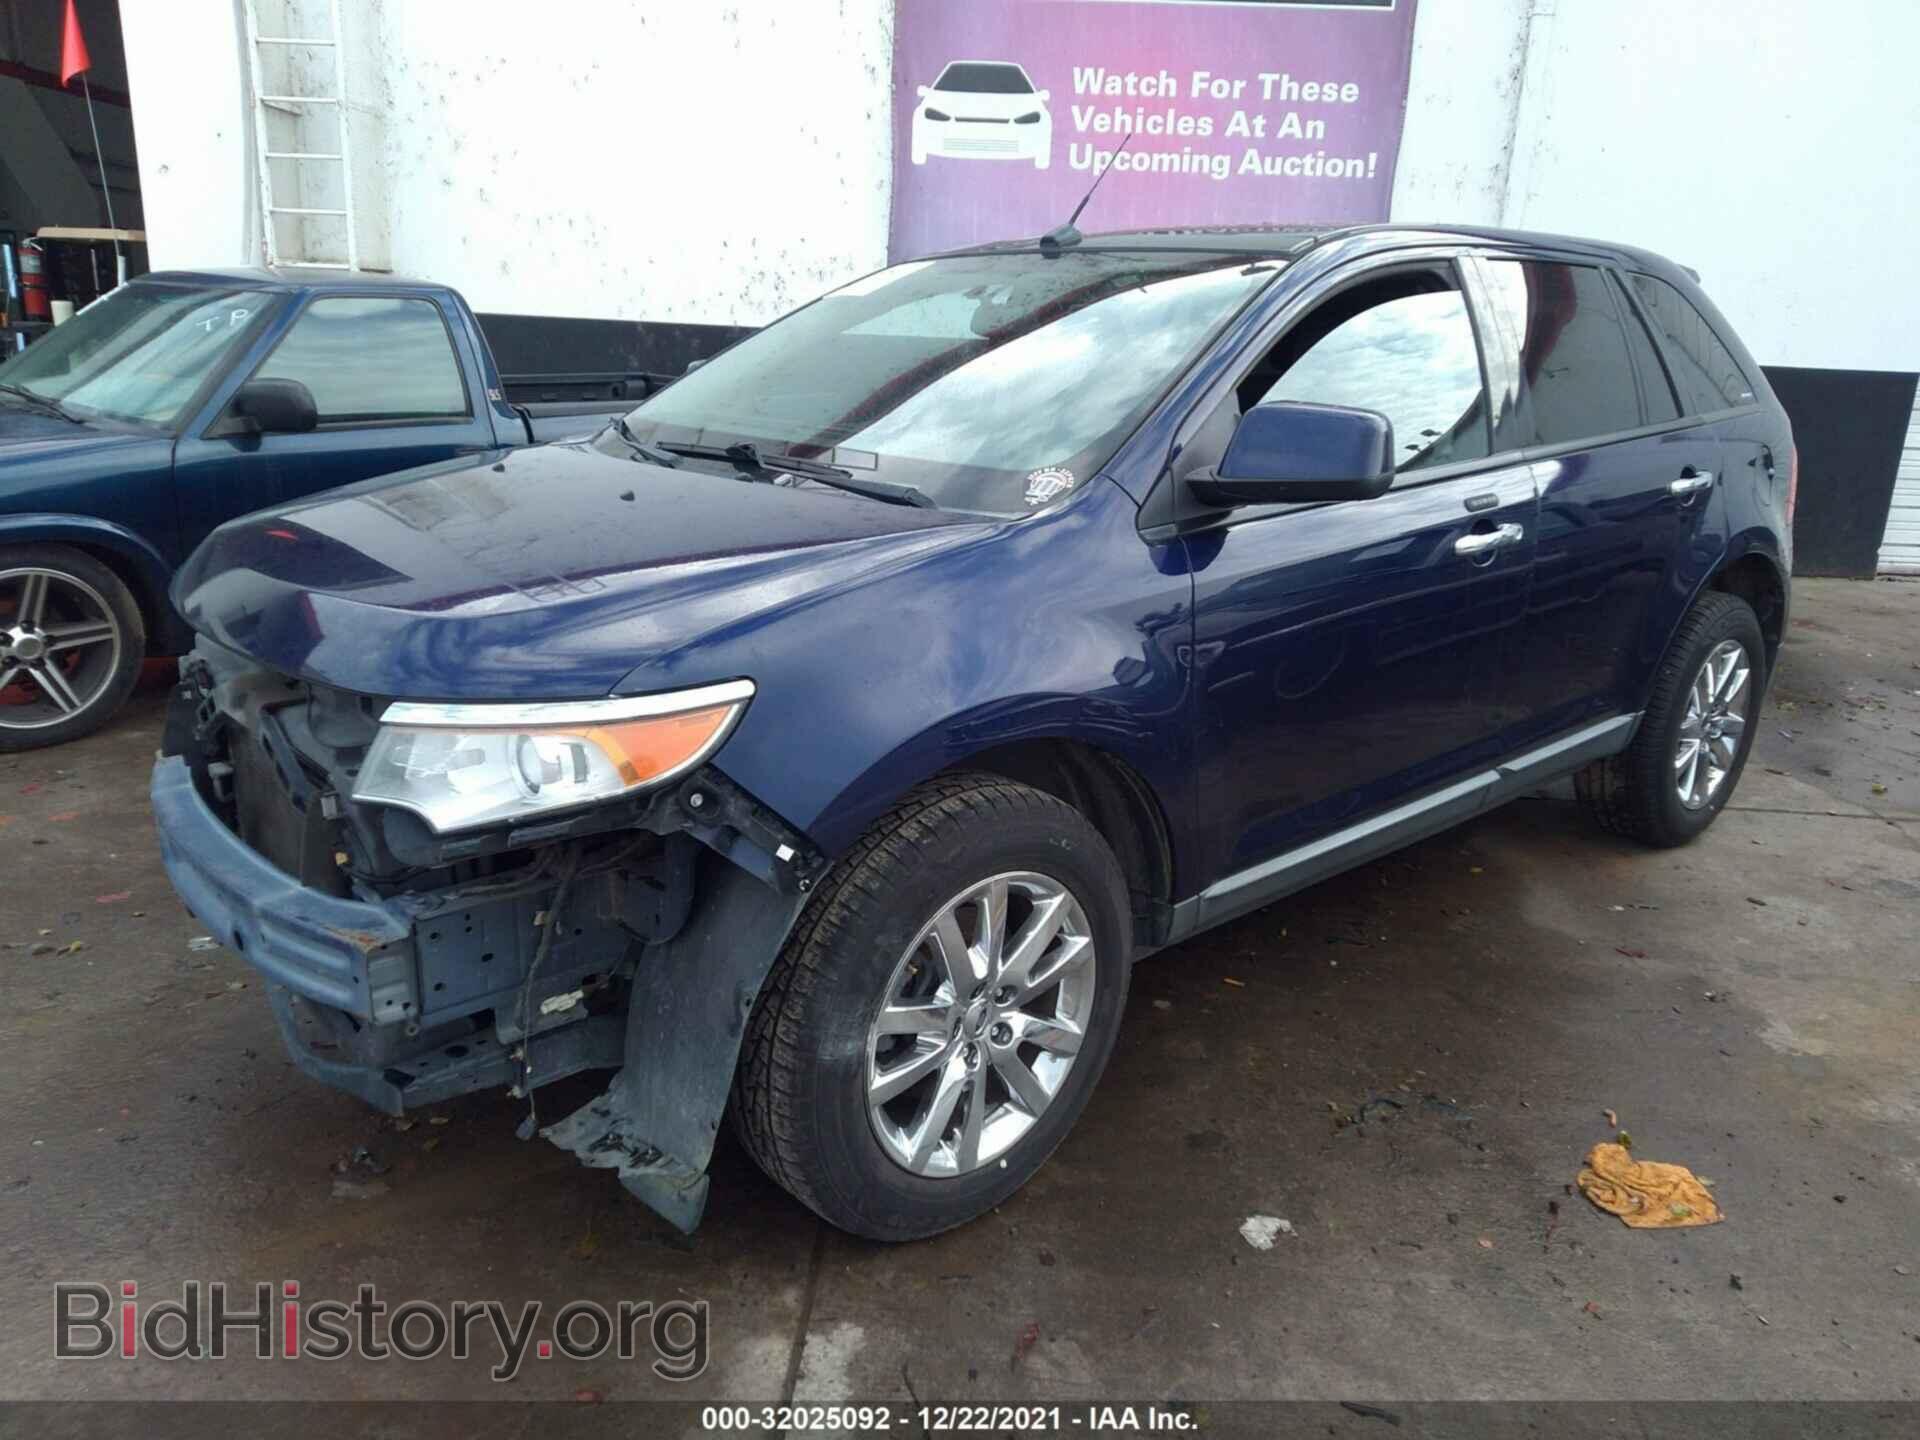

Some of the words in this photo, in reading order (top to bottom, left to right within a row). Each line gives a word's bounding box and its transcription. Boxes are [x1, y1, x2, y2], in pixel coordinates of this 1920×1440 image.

[1072, 66, 1177, 97] Watch
[1191, 71, 1246, 99] For
[1257, 72, 1359, 102] These
[1071, 105, 1213, 137] Vehicles
[1225, 110, 1266, 138] At
[1276, 111, 1325, 139] An
[1069, 143, 1231, 181] Upcoming
[1237, 148, 1378, 178] Auction!
